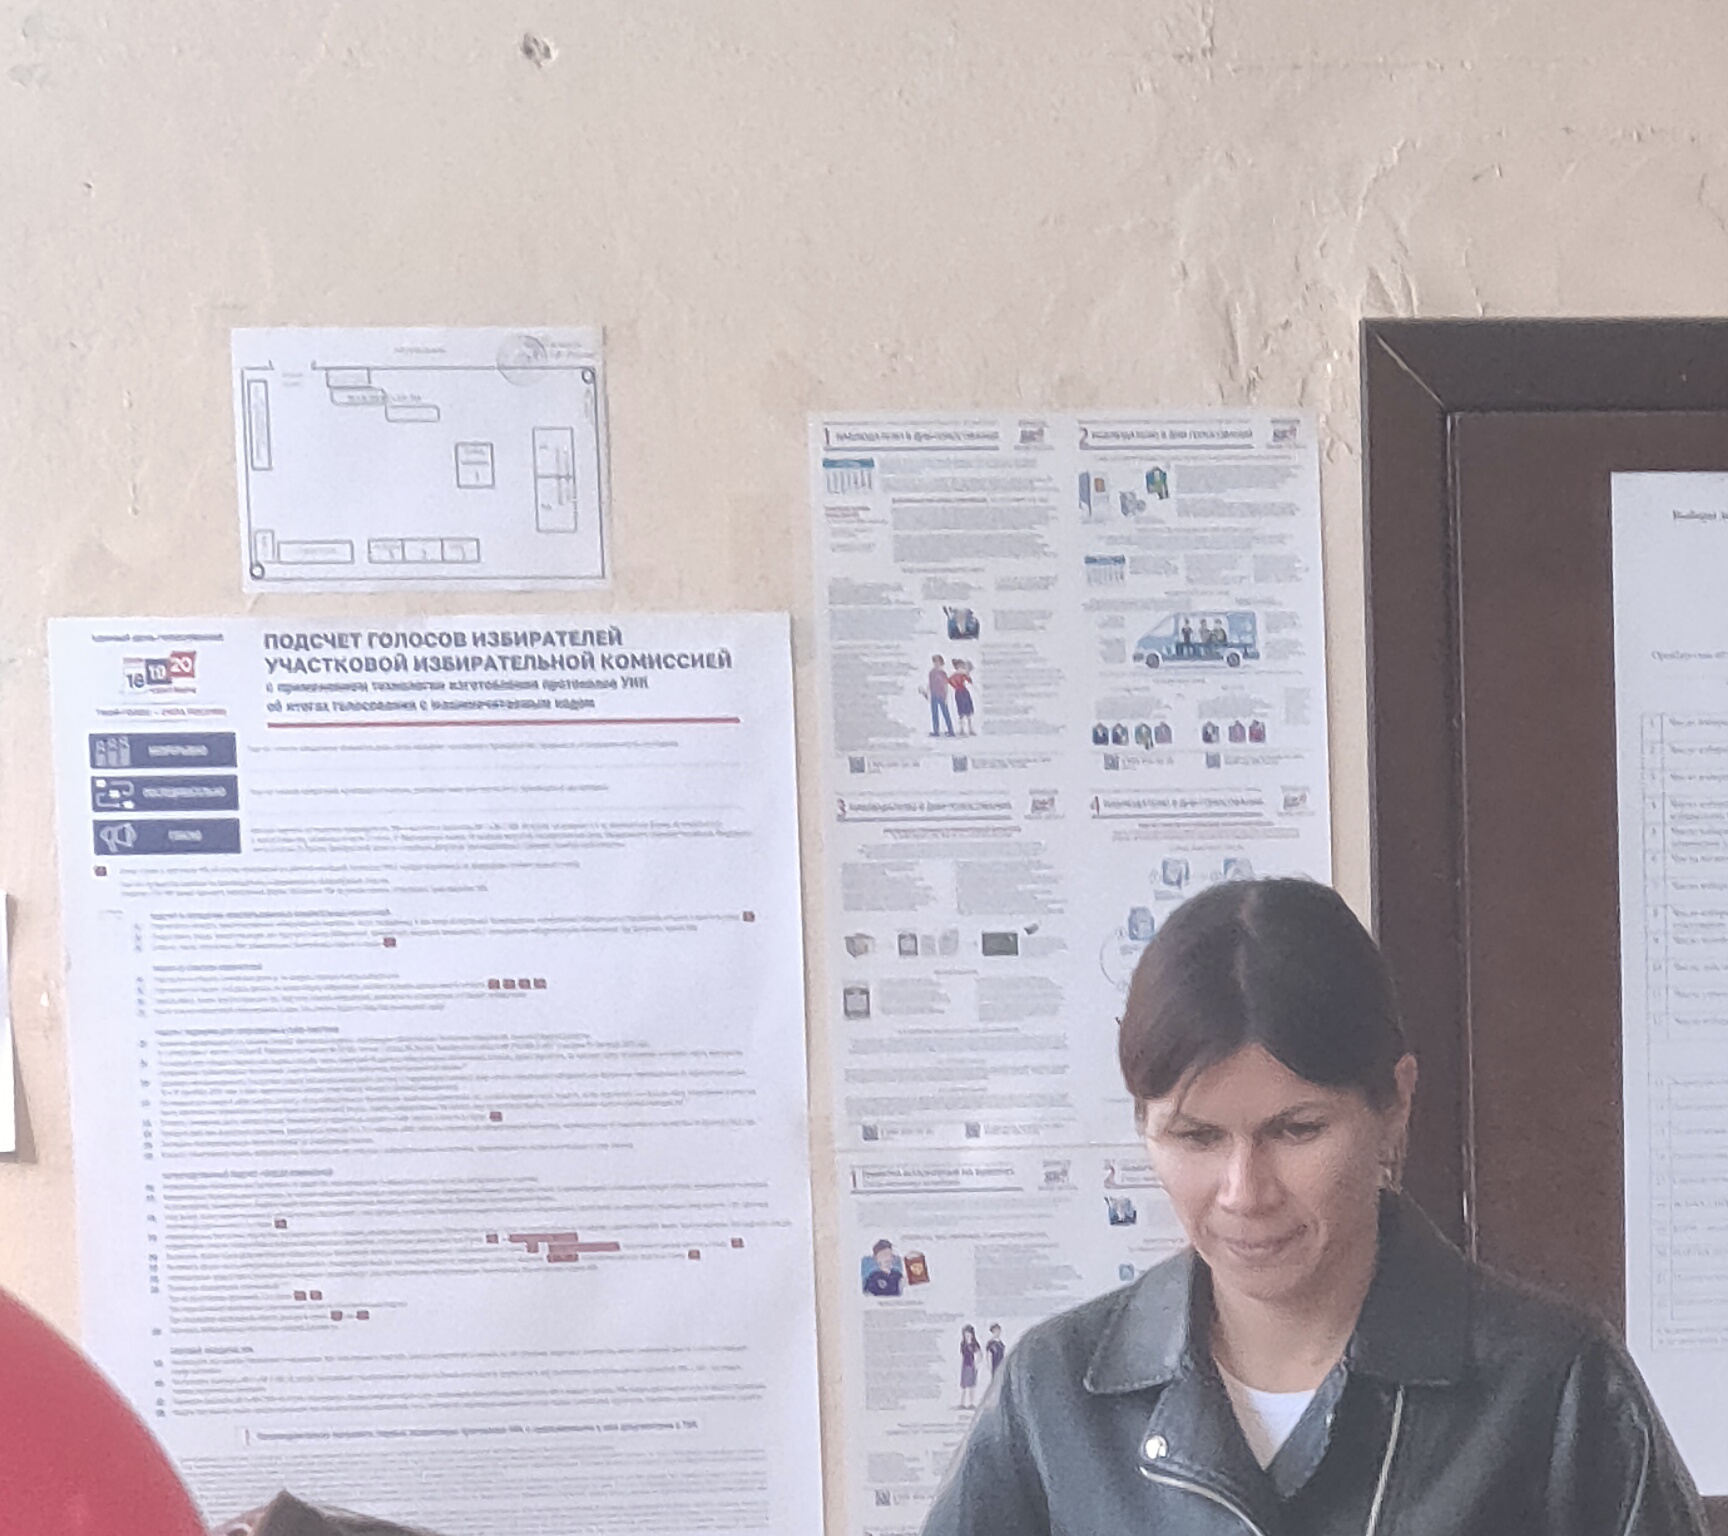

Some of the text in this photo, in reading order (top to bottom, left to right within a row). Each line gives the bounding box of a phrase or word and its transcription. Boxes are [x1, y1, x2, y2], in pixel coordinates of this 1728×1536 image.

[264, 625, 623, 651] ПОДСЧЕТ ГОЛОСОВ ИЗБИРАТЕЛЕЙ
[170, 656, 192, 673] 20
[265, 647, 733, 674] УЧАСТКОВОЙ ИЗБИРАТЕЛЬНОЙ КОМИССИЕЙ
[126, 673, 144, 688] 18
